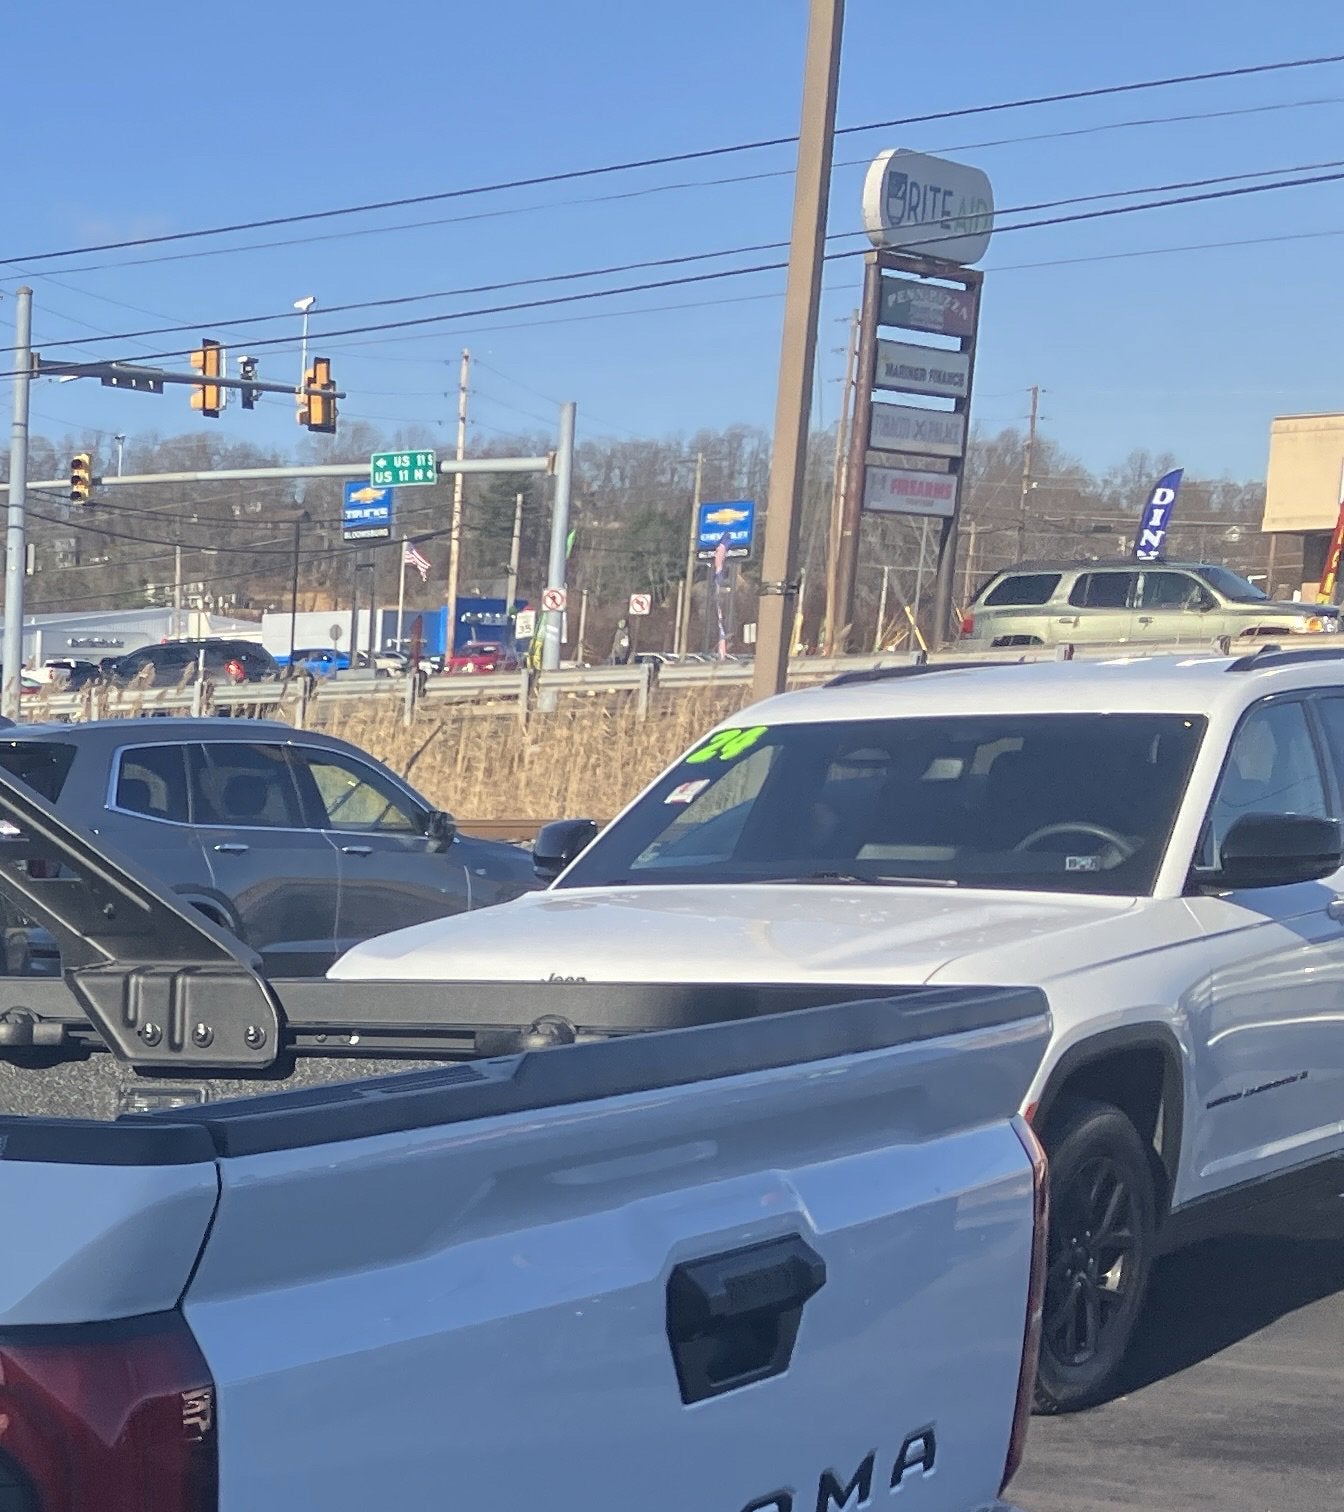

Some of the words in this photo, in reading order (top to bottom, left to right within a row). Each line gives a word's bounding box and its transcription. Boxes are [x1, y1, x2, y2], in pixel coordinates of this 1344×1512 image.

[908, 181, 953, 230] RITE
[954, 197, 992, 233] AID
[930, 289, 968, 321] PIZZA
[375, 470, 392, 483] US
[399, 469, 409, 481] 11
[414, 468, 424, 480] N
[393, 455, 411, 467] US
[685, 725, 769, 764] 24
